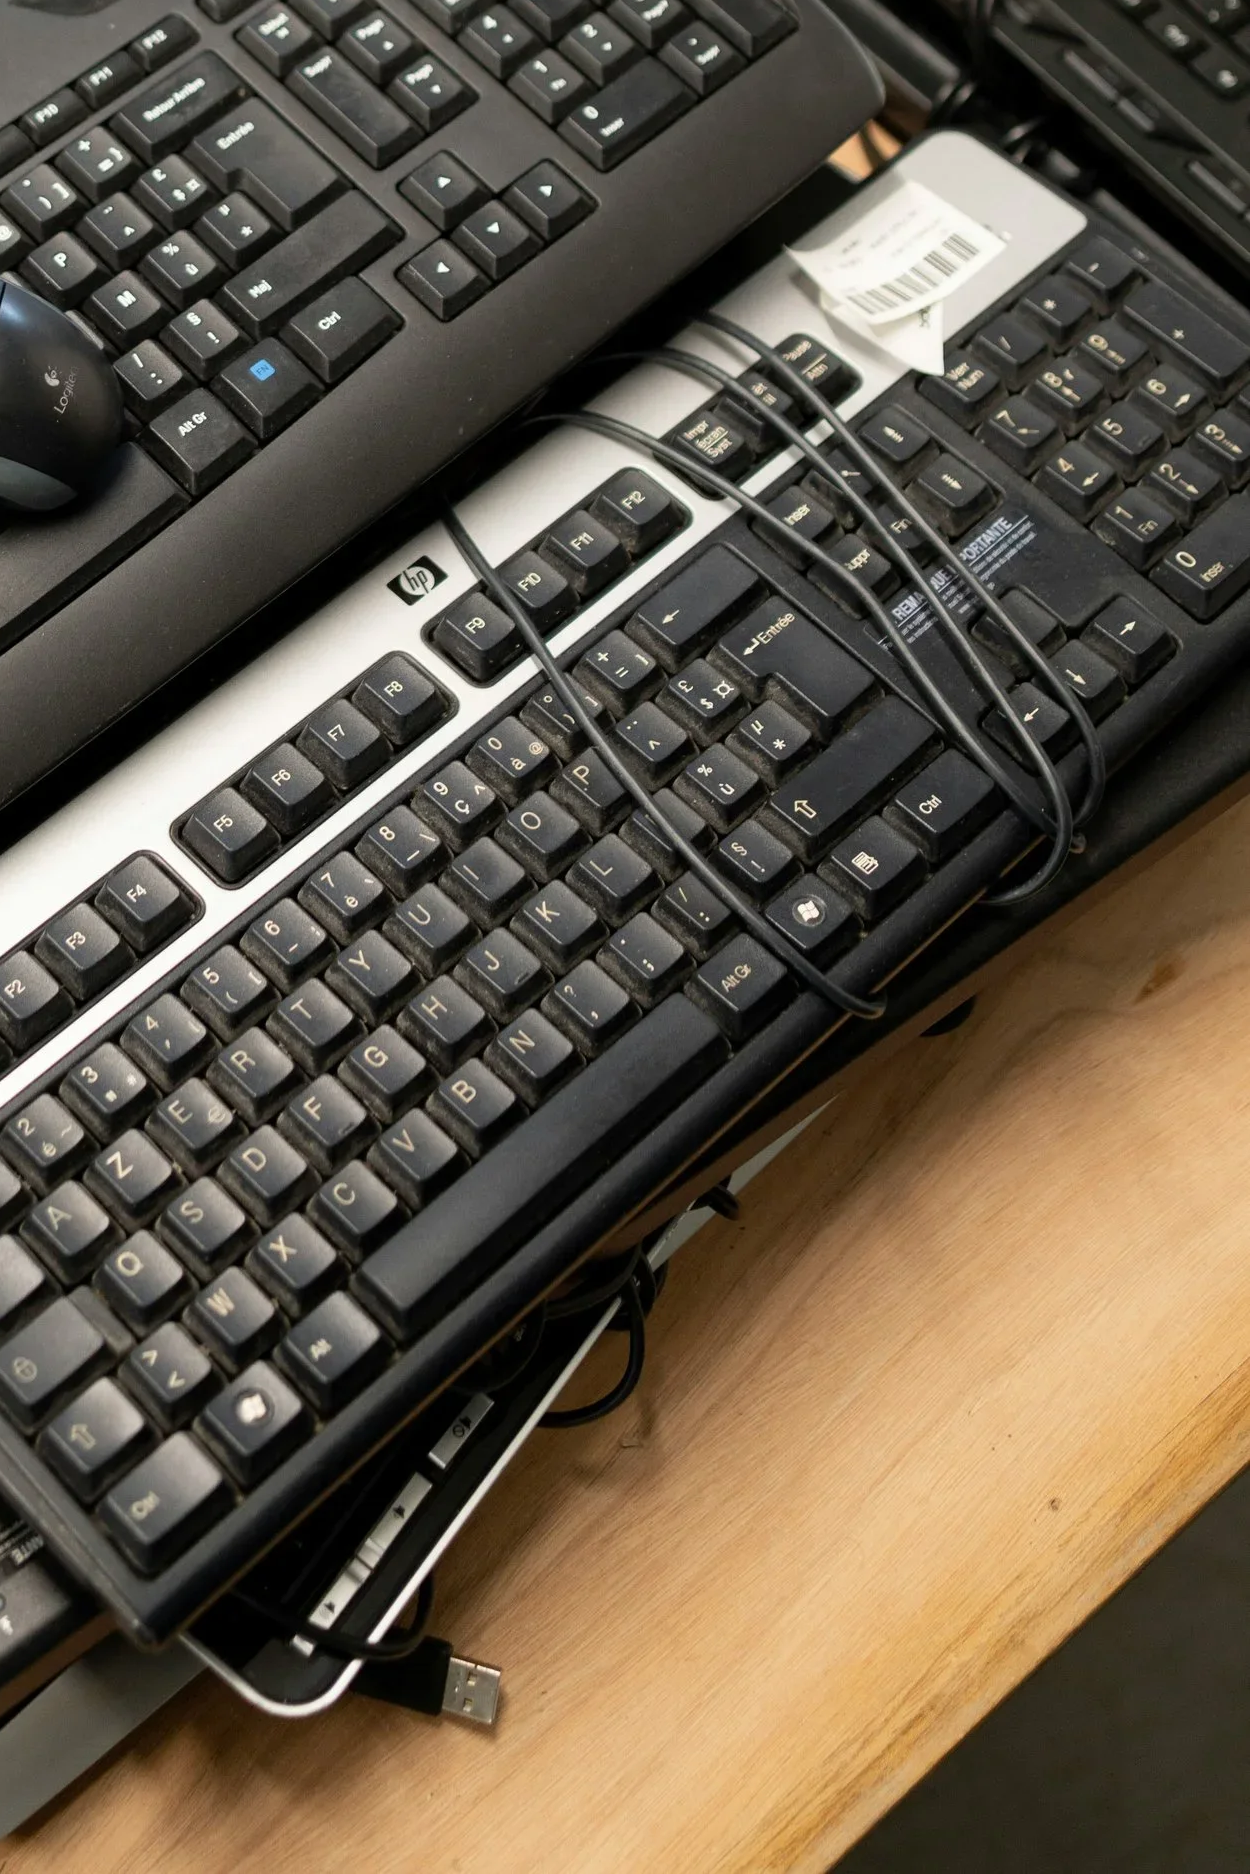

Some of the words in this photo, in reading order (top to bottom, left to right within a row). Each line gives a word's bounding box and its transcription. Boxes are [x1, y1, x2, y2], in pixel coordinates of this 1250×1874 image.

[143, 30, 167, 48] F12
[90, 67, 112, 85] F11
[35, 104, 58, 122] F10
[54, 253, 66, 267] P
[117, 291, 136, 307] M
[318, 310, 342, 331] Ctrl
[1087, 334, 1108, 351] 9
[956, 369, 985, 391] Num
[1043, 372, 1062, 387] 8
[1147, 379, 1166, 394] 6
[178, 422, 196, 436] Alt
[191, 411, 207, 425] Gr
[996, 410, 1015, 426] 7
[1103, 419, 1122, 435] 5
[683, 420, 709, 438] Impr
[1204, 424, 1226, 441] 3
[707, 438, 733, 458] Syst
[1058, 457, 1075, 474] 4
[1158, 463, 1181, 482] 2
[622, 491, 645, 509] F12
[784, 504, 810, 525] Inser
[1116, 506, 1133, 519] 1
[570, 533, 593, 550] F11
[1176, 552, 1196, 567] 0
[1200, 562, 1224, 582] Inser
[518, 573, 541, 591] F10
[465, 617, 485, 633] F9
[757, 613, 794, 644] Entrée
[384, 681, 403, 697] F8
[327, 724, 345, 741] F7
[487, 737, 503, 751] 0
[272, 768, 292, 787] F6
[573, 766, 589, 784] P
[433, 782, 449, 798] 9
[919, 795, 942, 814] Ctrl
[214, 815, 233, 832] F5
[521, 812, 541, 829] O
[379, 826, 395, 840] 8
[592, 859, 614, 879] L
[320, 873, 337, 889] 7
[127, 885, 146, 902] F4
[411, 904, 432, 926] U
[535, 903, 559, 923] K
[265, 921, 280, 935] 6
[66, 932, 85, 950] F3
[349, 950, 370, 971] Y
[484, 950, 503, 971] J
[203, 968, 219, 983] 5
[721, 973, 739, 993] Alt
[733, 963, 752, 979] Gr
[4, 980, 25, 998] F2
[291, 998, 314, 1021] T
[428, 997, 450, 1019] H
[143, 1014, 160, 1031] 4
[509, 1030, 535, 1053] N
[231, 1051, 255, 1072] R
[364, 1046, 388, 1067] G
[81, 1067, 98, 1083] 3
[452, 1080, 476, 1103] B
[168, 1100, 192, 1123] E
[304, 1098, 324, 1121] F
[18, 1118, 34, 1136] 2
[393, 1130, 414, 1151] V
[106, 1152, 132, 1178] Z
[242, 1148, 266, 1171] D
[334, 1182, 358, 1206] C
[47, 1206, 71, 1230] A
[181, 1200, 204, 1224] S
[270, 1236, 296, 1262] X
[116, 1252, 142, 1276] Q
[206, 1288, 234, 1316] W
[308, 1339, 332, 1362] Alt
[132, 1492, 159, 1519] Ctrl
